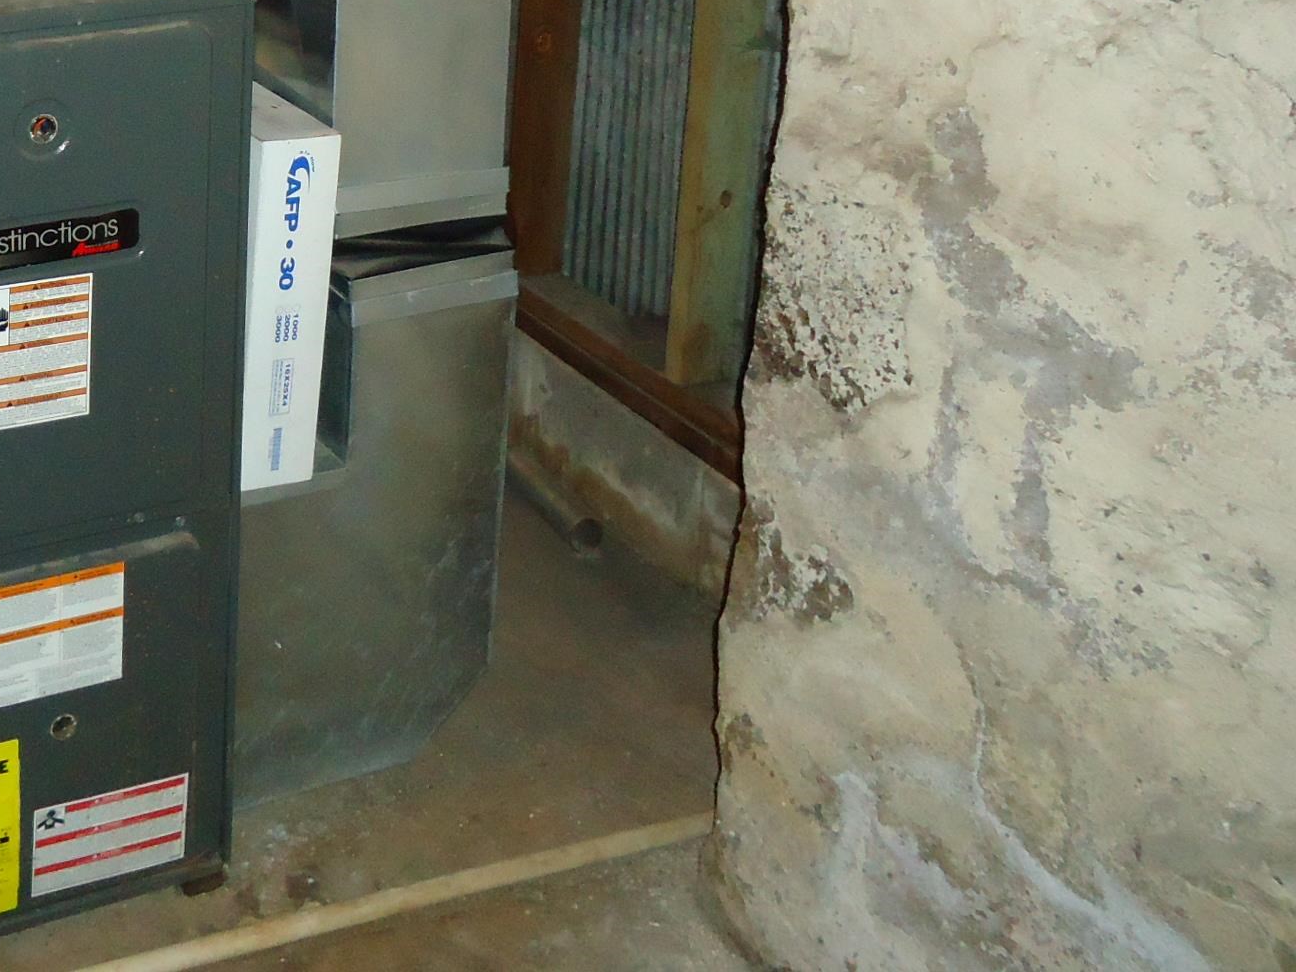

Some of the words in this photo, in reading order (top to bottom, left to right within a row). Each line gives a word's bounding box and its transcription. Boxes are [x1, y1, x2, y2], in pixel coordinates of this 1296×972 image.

[279, 257, 295, 291] 30
[274, 315, 283, 343] 3000
[283, 314, 291, 342] 2000
[291, 313, 299, 341] 1000
